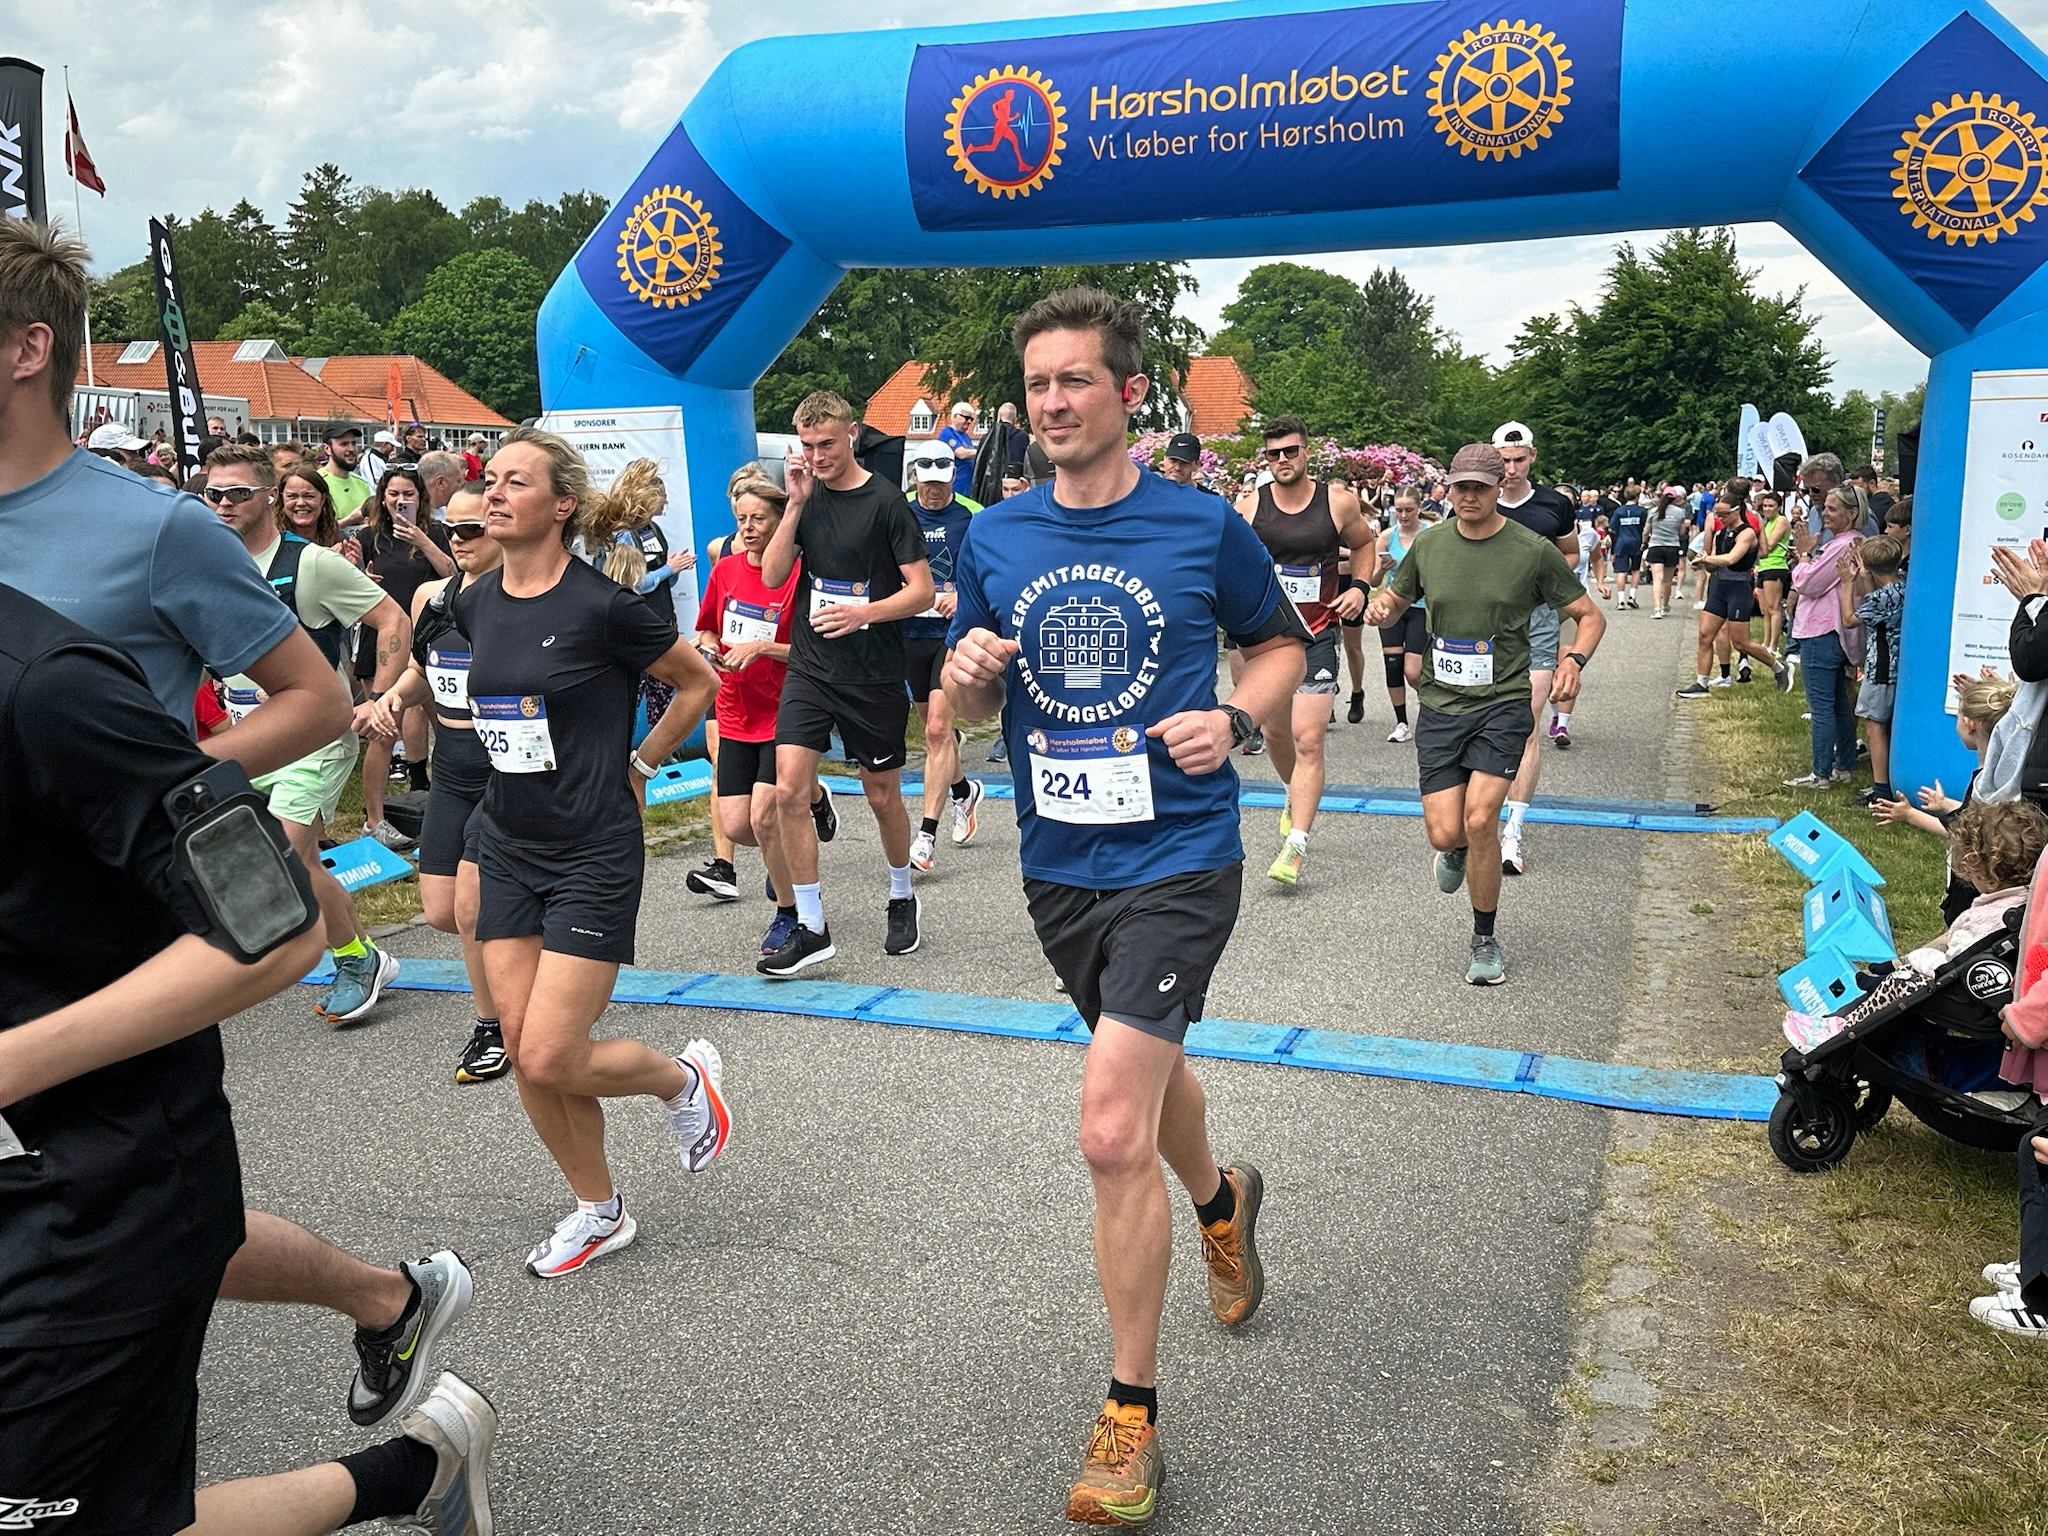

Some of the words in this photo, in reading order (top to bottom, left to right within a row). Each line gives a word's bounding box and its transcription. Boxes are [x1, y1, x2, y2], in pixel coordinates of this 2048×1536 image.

[1471, 32, 1531, 52] ROTARY
[1089, 65, 1409, 121] Hørsholmløbet
[1088, 134, 1117, 160] Vi
[1127, 131, 1199, 159] løber
[1209, 125, 1249, 152] for
[1259, 112, 1404, 148] Hørsholm
[1449, 105, 1551, 147] INTERNATIONAL
[1987, 109, 2039, 154] ROTARY
[1908, 155, 1995, 230] INTERNATIONAL
[628, 201, 659, 240] ROTARY
[656, 229, 710, 296] INTERNATIONAL
[573, 419, 616, 428] SPONSORER
[575, 443, 600, 452] SKJERN
[602, 442, 626, 450] BANK
[1011, 563, 1166, 628] EREMITAGELØBET
[730, 619, 743, 636] 81
[1437, 657, 1463, 675] 463
[437, 675, 457, 694] 35
[1016, 656, 1160, 723] EREMITAGELØBET
[480, 729, 509, 754] 225
[1049, 736, 1108, 747] Hørsholmløbet
[651, 776, 713, 799] SPORTSTIMING
[1041, 769, 1092, 800] 224
